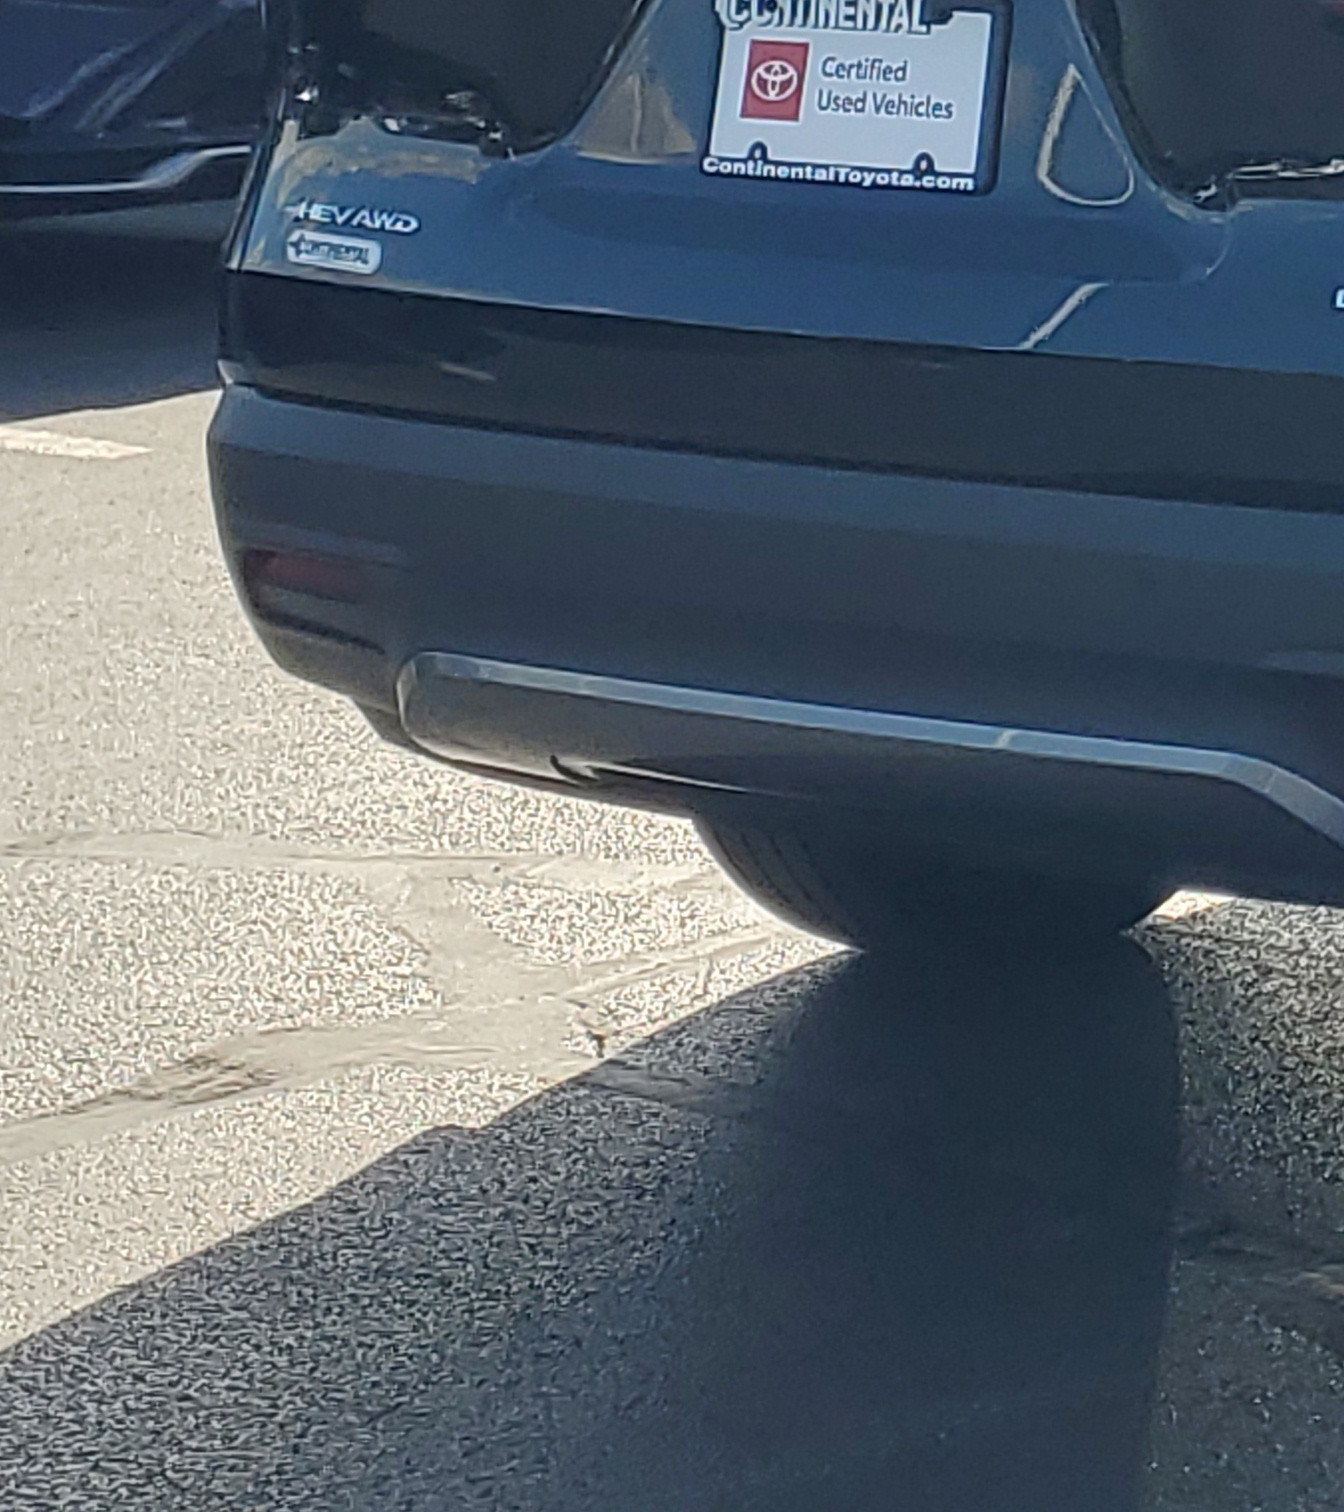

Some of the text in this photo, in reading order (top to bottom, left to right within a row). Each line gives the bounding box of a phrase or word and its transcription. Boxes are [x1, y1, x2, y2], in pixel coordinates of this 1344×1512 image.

[820, 55, 908, 83] Certified
[816, 89, 954, 120] Used Vehicles
[702, 156, 975, 191] ContinentalToyota.com
